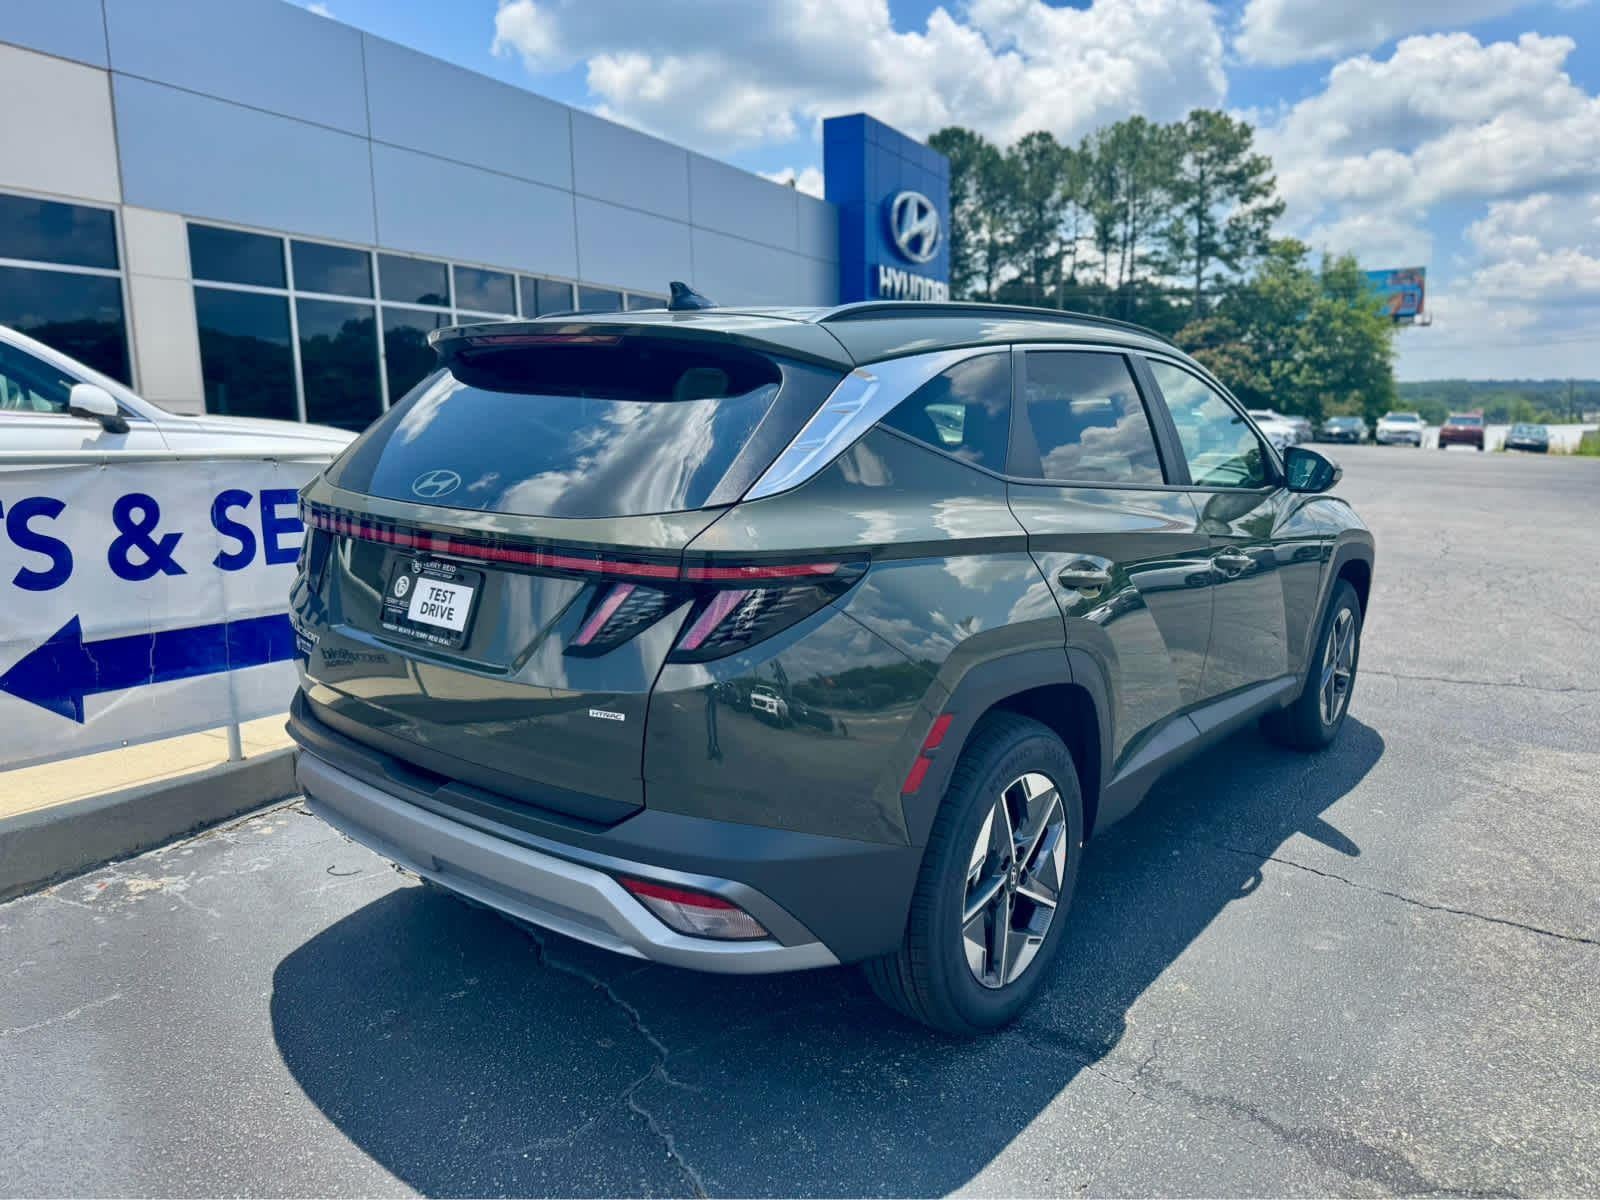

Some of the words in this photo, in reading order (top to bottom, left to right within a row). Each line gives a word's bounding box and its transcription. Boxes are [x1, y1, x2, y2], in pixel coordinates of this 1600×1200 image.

[879, 264, 950, 303] HYUNDAI
[0, 496, 74, 592] S
[107, 492, 188, 582] &
[429, 587, 456, 604] TEST
[420, 602, 455, 621] DRIVE
[591, 710, 624, 720] HTRAC
